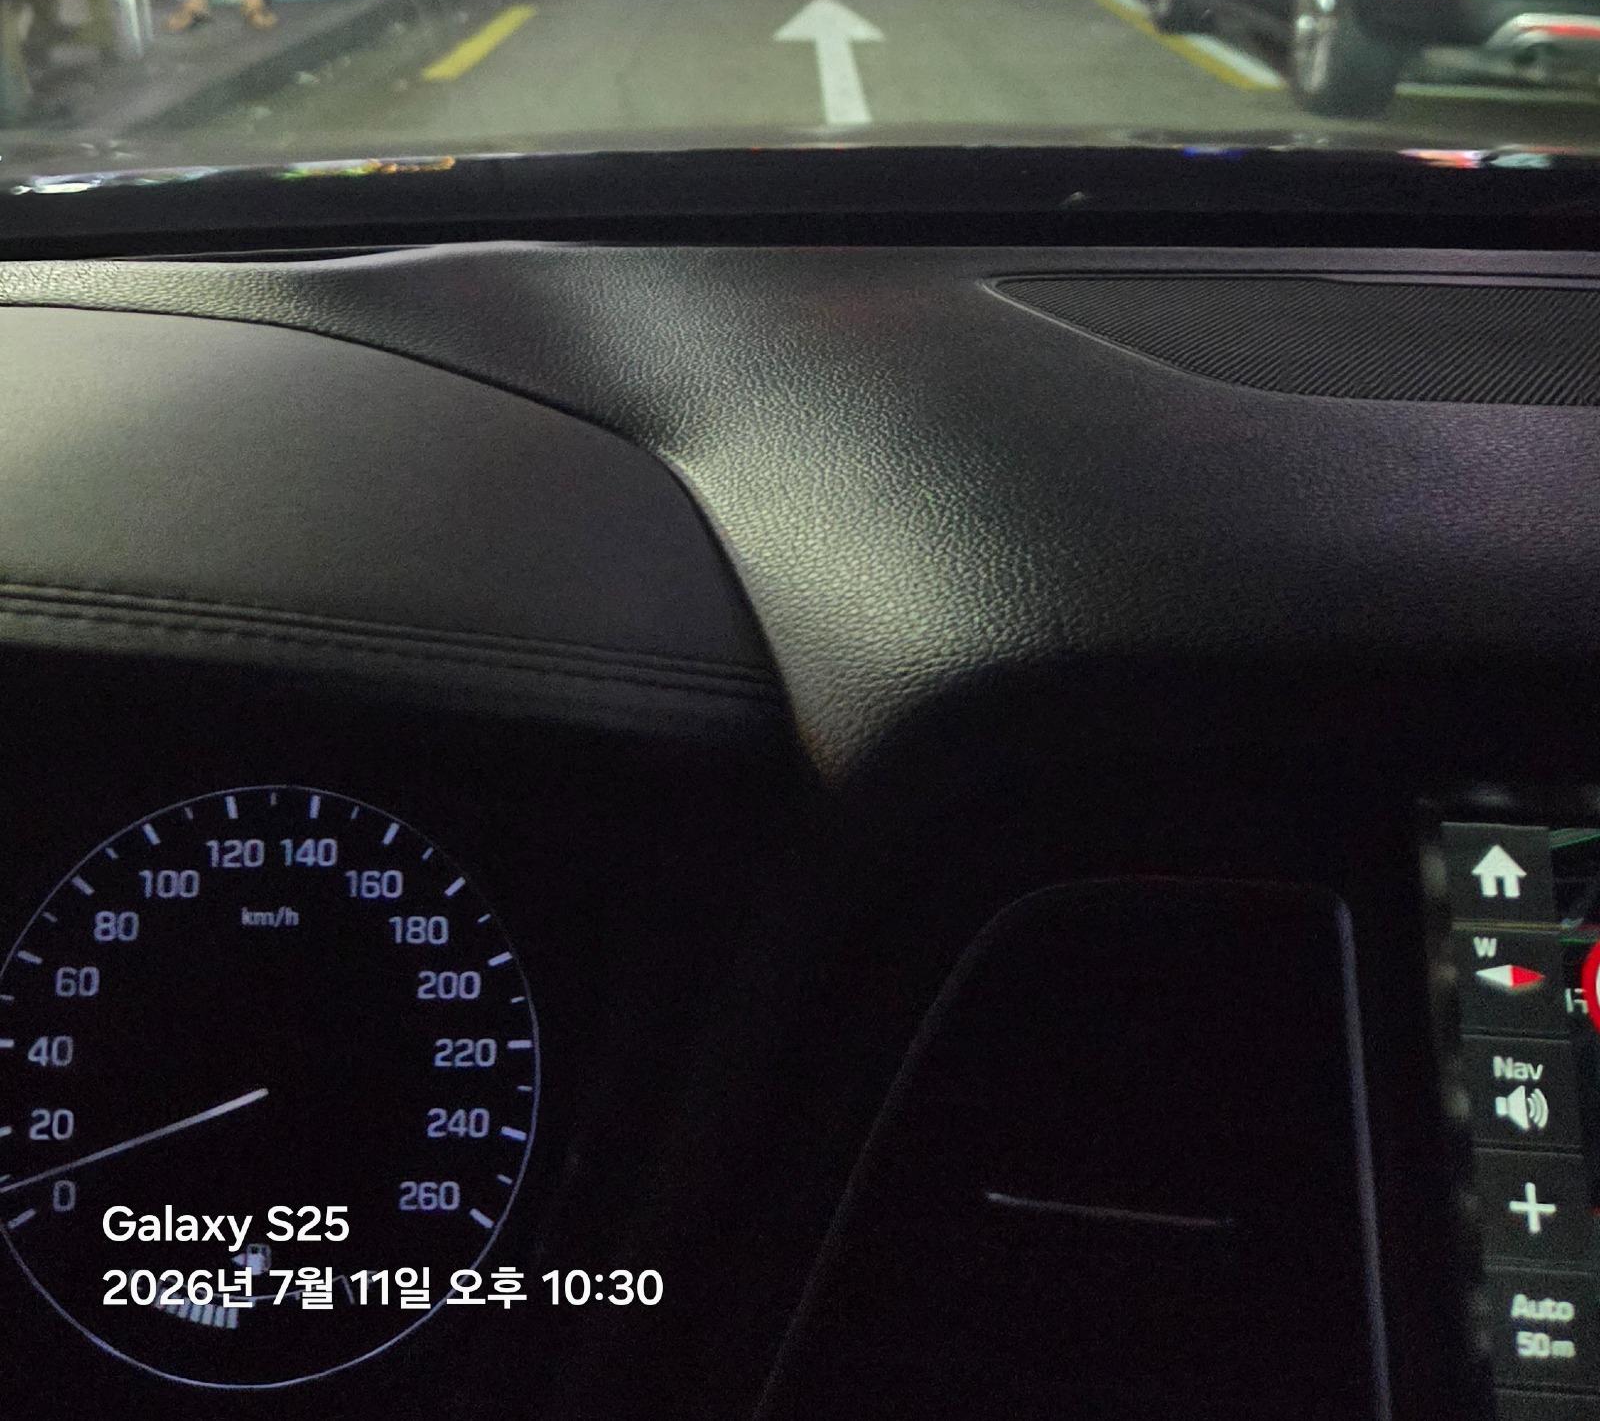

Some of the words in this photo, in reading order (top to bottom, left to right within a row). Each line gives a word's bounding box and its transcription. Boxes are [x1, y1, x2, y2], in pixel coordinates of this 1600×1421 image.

[206, 839, 265, 868] 120
[280, 839, 338, 867] 140
[139, 869, 199, 898] 100
[346, 869, 403, 898] 160
[94, 911, 139, 941] 80
[241, 906, 299, 928] km/h
[389, 915, 449, 945] 180
[1473, 936, 1498, 958] W
[56, 966, 99, 997] 60
[417, 970, 481, 1000] 200
[27, 1035, 73, 1067] 40
[434, 1038, 497, 1067] 220
[1492, 1055, 1544, 1081] Nav
[29, 1109, 74, 1141] 20
[427, 1107, 490, 1138] 240
[53, 1180, 75, 1212] 0
[400, 1181, 460, 1211] 260
[1510, 1293, 1575, 1323] Auto
[1516, 1330, 1576, 1359] 50m
